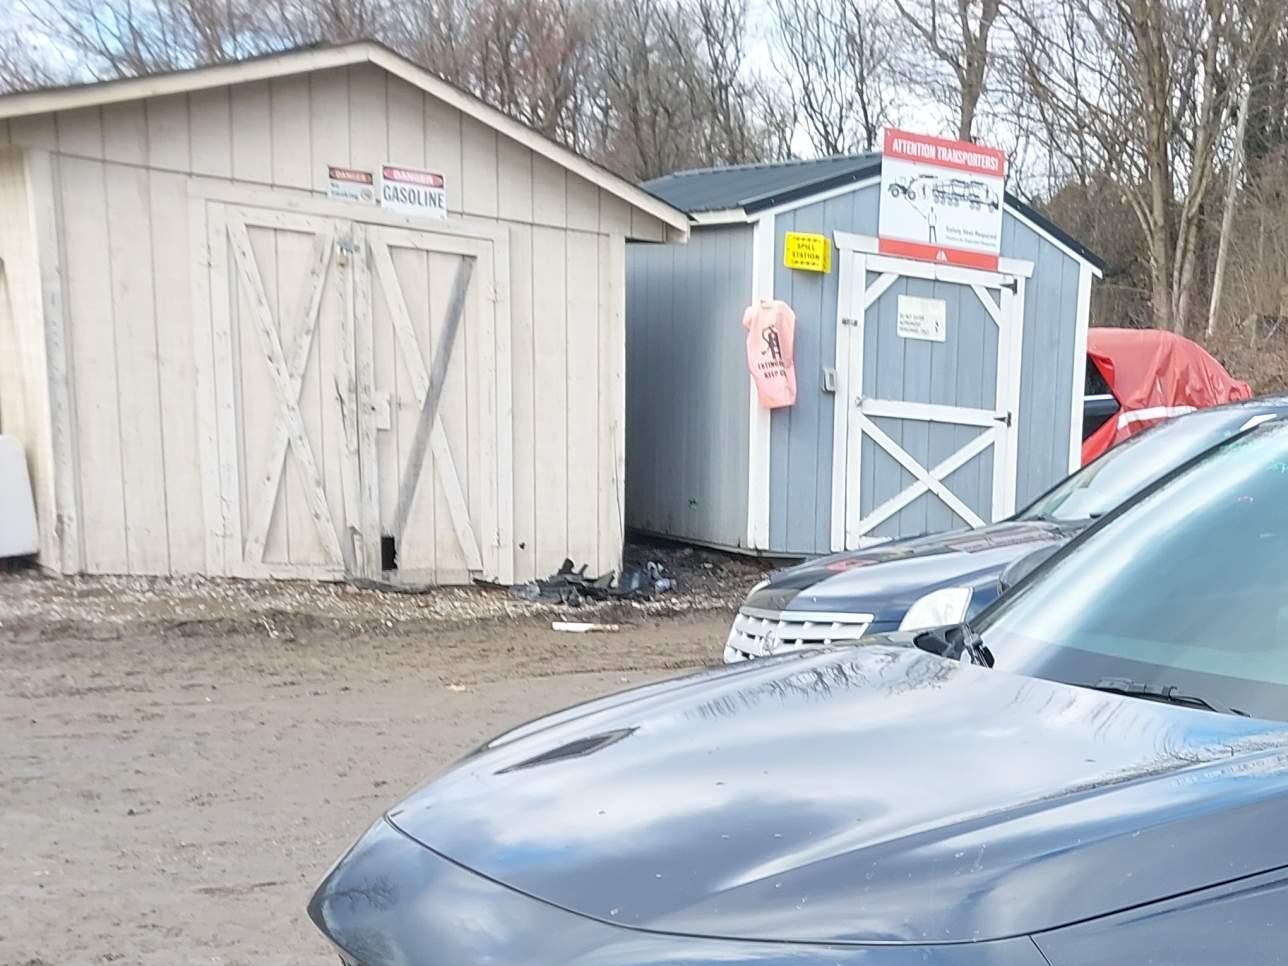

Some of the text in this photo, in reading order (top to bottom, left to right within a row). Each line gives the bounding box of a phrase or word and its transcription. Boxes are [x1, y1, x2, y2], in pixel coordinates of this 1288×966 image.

[892, 138, 999, 171] ATTENTION TRANSPORTERS!
[393, 169, 433, 185] DANGER
[383, 184, 445, 209] GASOLINE
